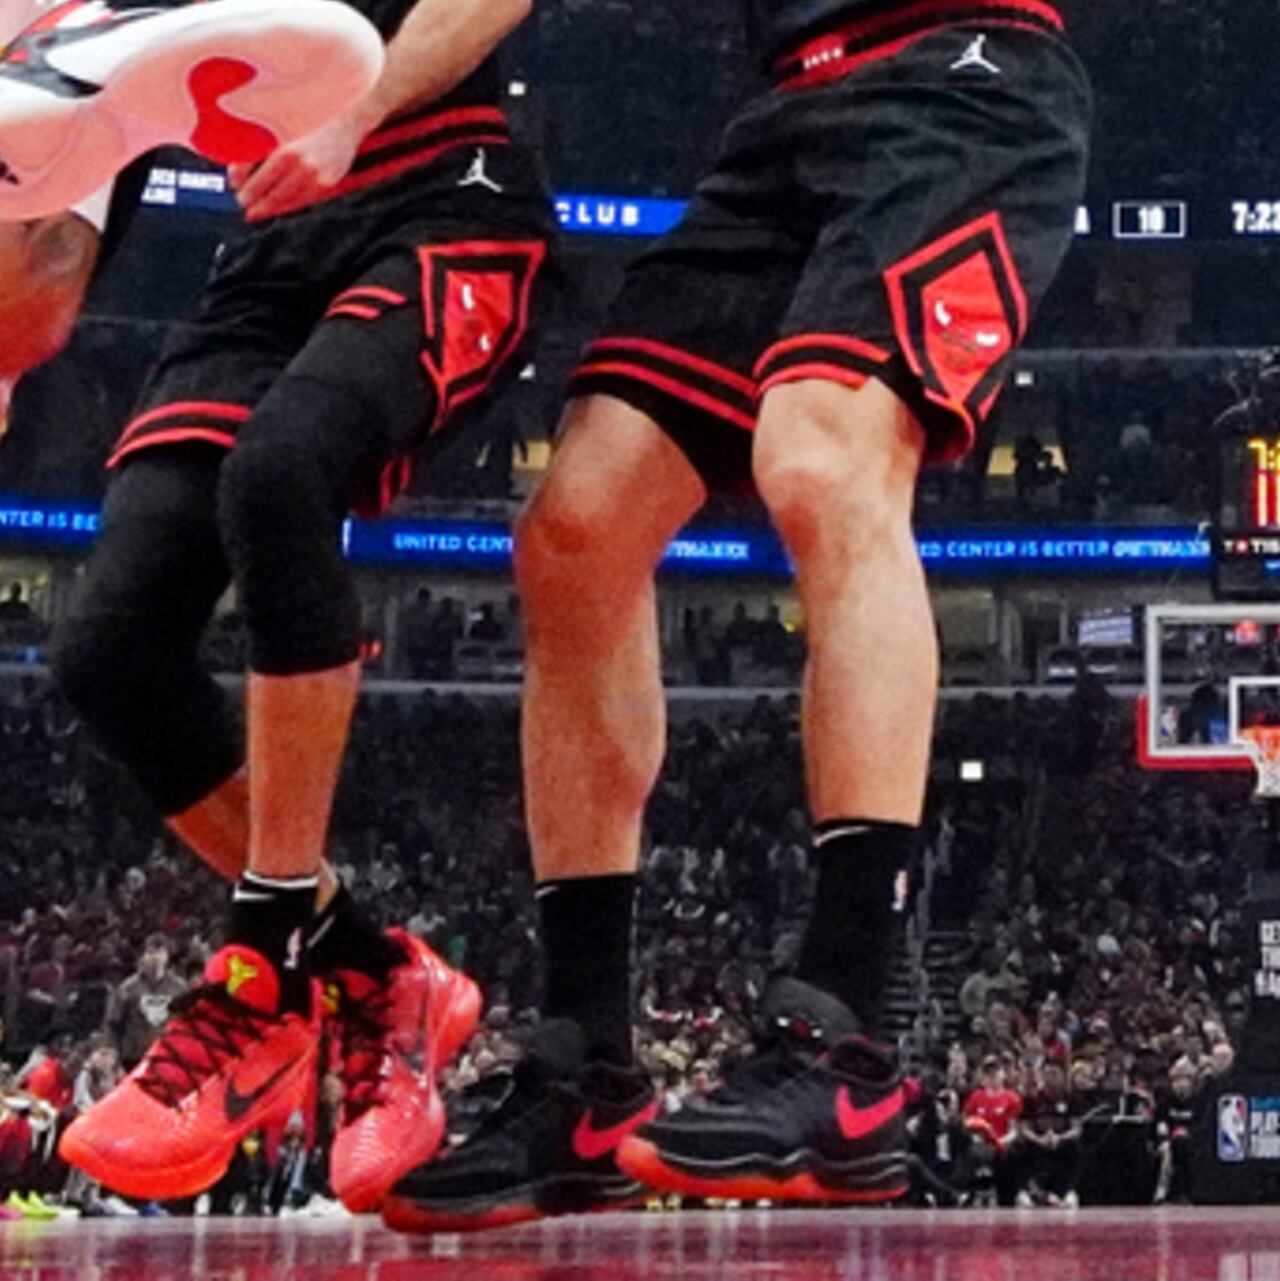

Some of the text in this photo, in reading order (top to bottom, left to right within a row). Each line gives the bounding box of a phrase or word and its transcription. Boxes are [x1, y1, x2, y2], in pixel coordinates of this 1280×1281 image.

[393, 532, 514, 554] UNITED CENT
[946, 540, 1017, 559] CENTER
[1021, 540, 1039, 558] IS
[1042, 540, 1109, 558] BETTER
